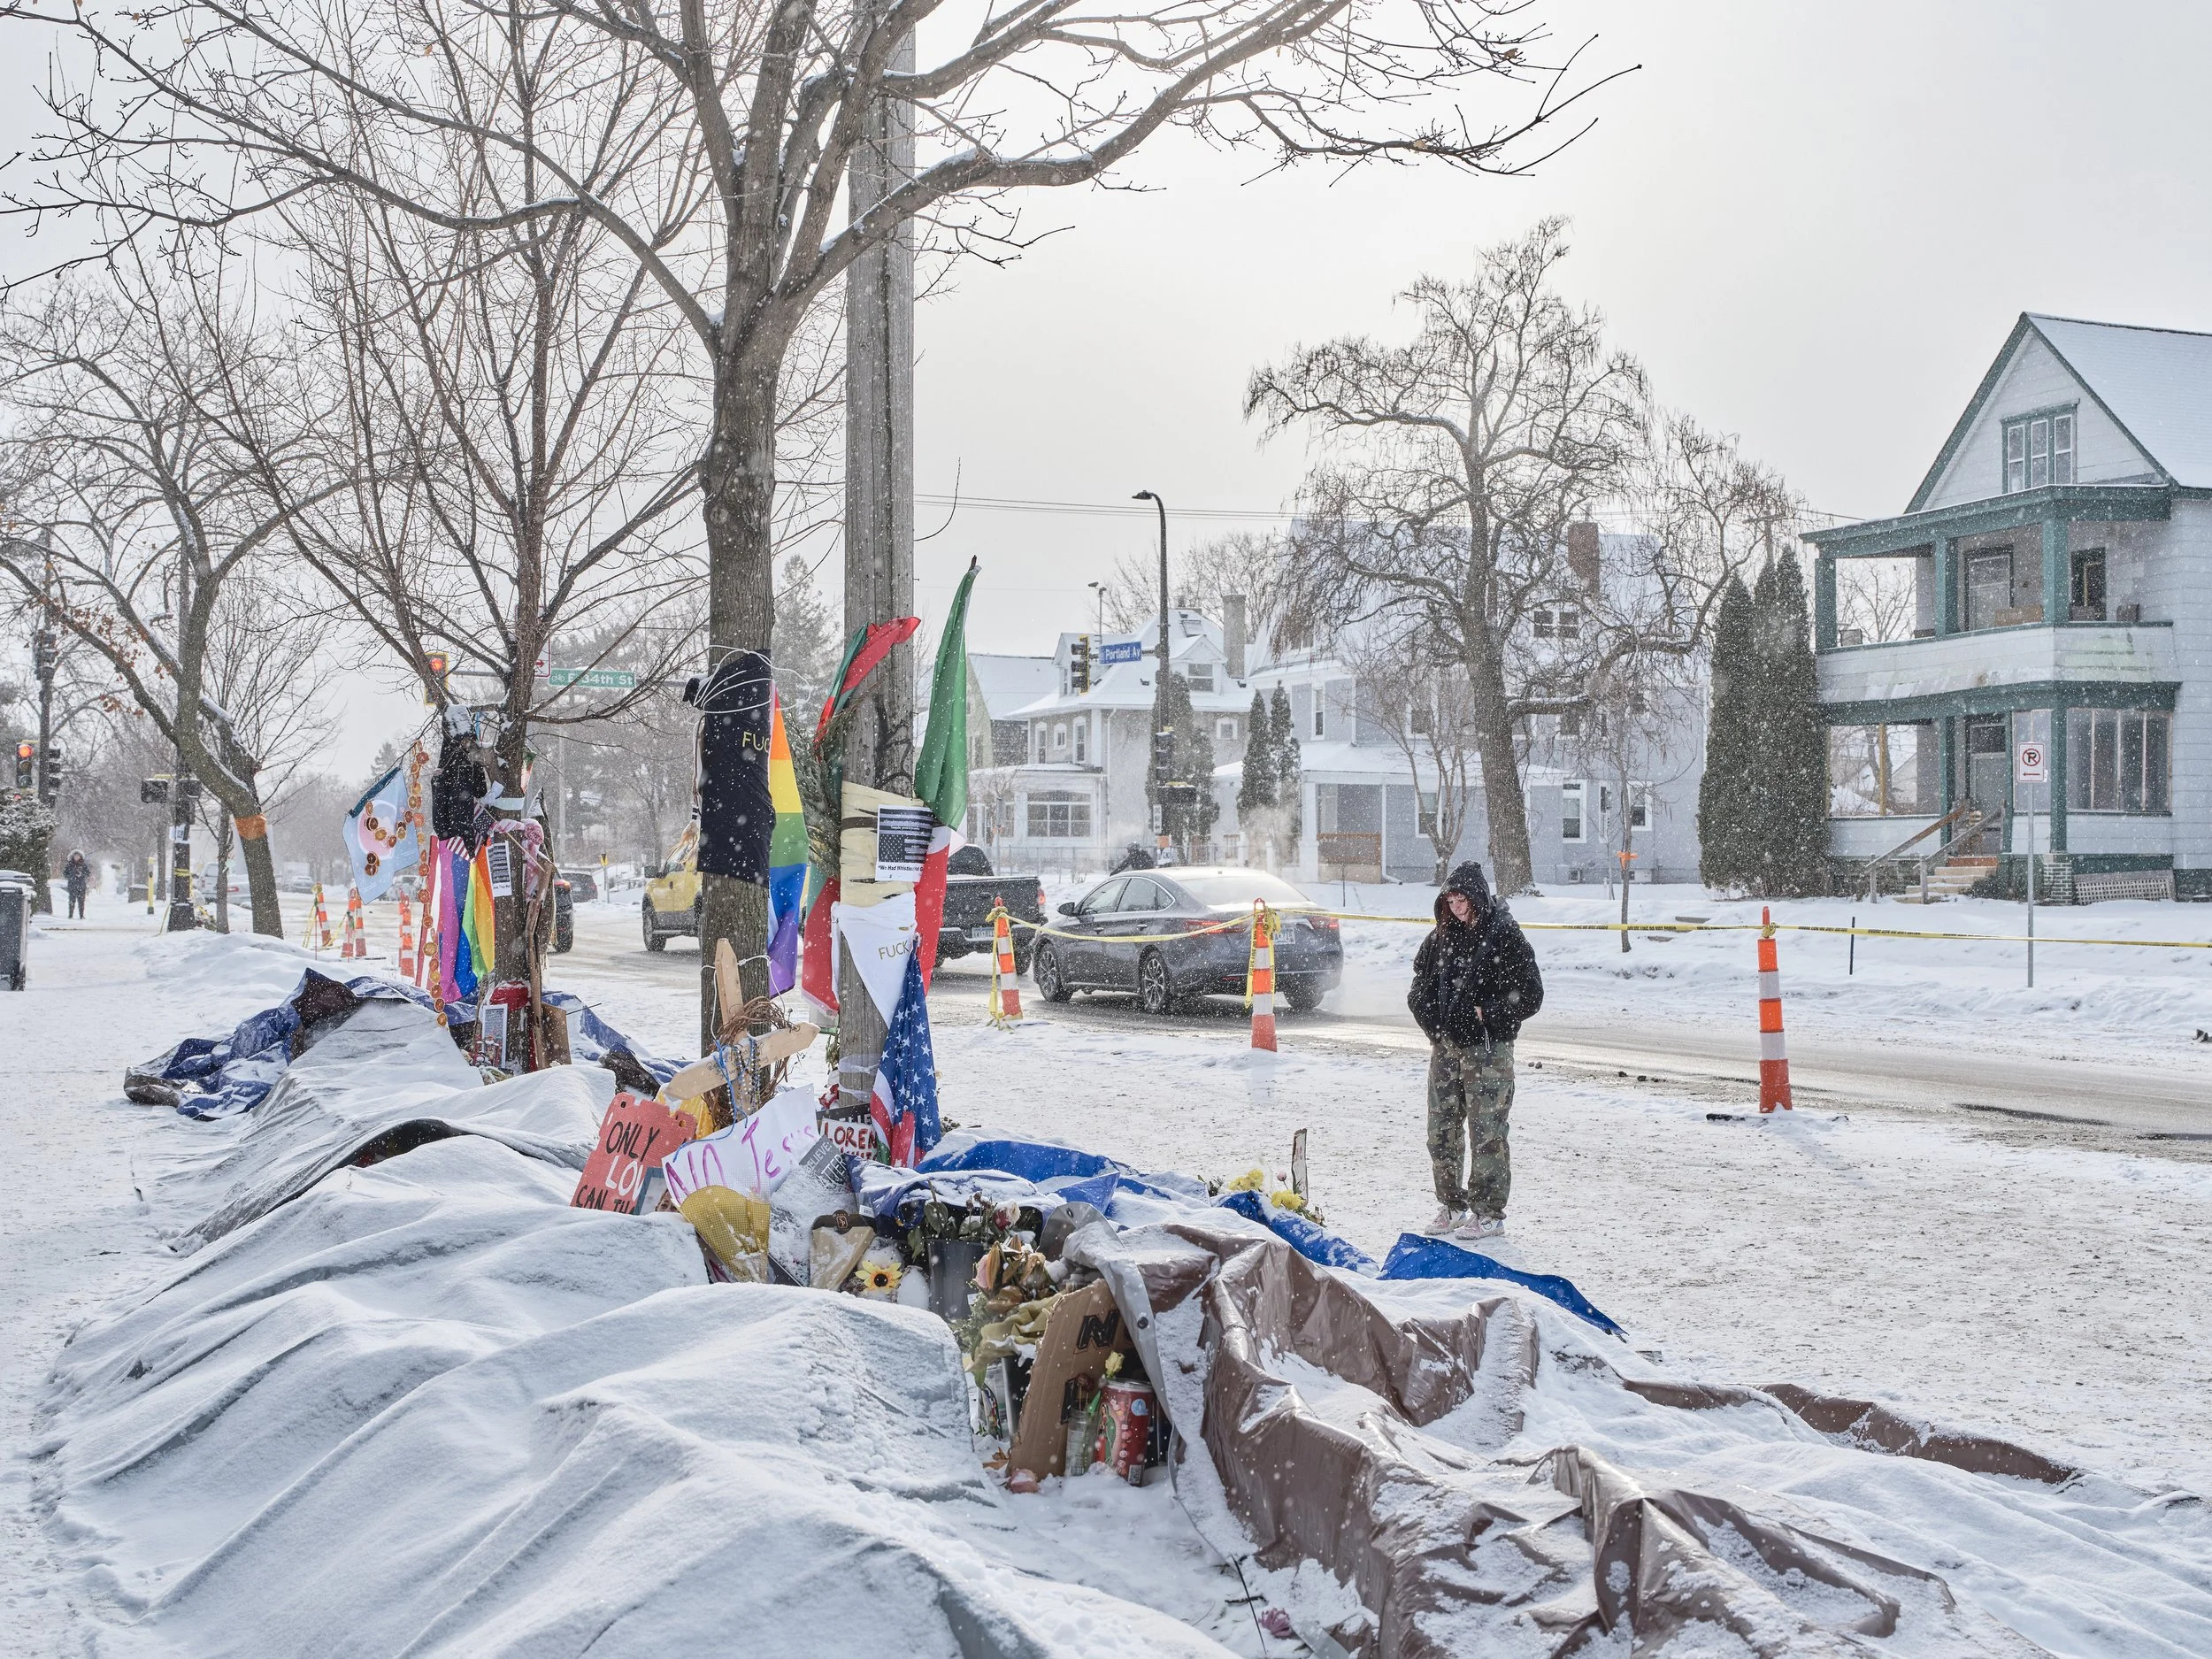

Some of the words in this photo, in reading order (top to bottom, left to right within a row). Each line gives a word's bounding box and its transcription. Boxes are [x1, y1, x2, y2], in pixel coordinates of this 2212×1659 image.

[1105, 647, 1130, 660] Portland
[1133, 646, 1141, 658] Av
[567, 673, 576, 683] E
[581, 674, 613, 685] 34th
[618, 675, 633, 686] St
[878, 940, 910, 960] FUCK
[606, 1121, 661, 1163] ONLY
[824, 1122, 878, 1149] LOREN
[806, 1141, 833, 1171] ELIEVE:
[576, 1185, 609, 1210] CAN
